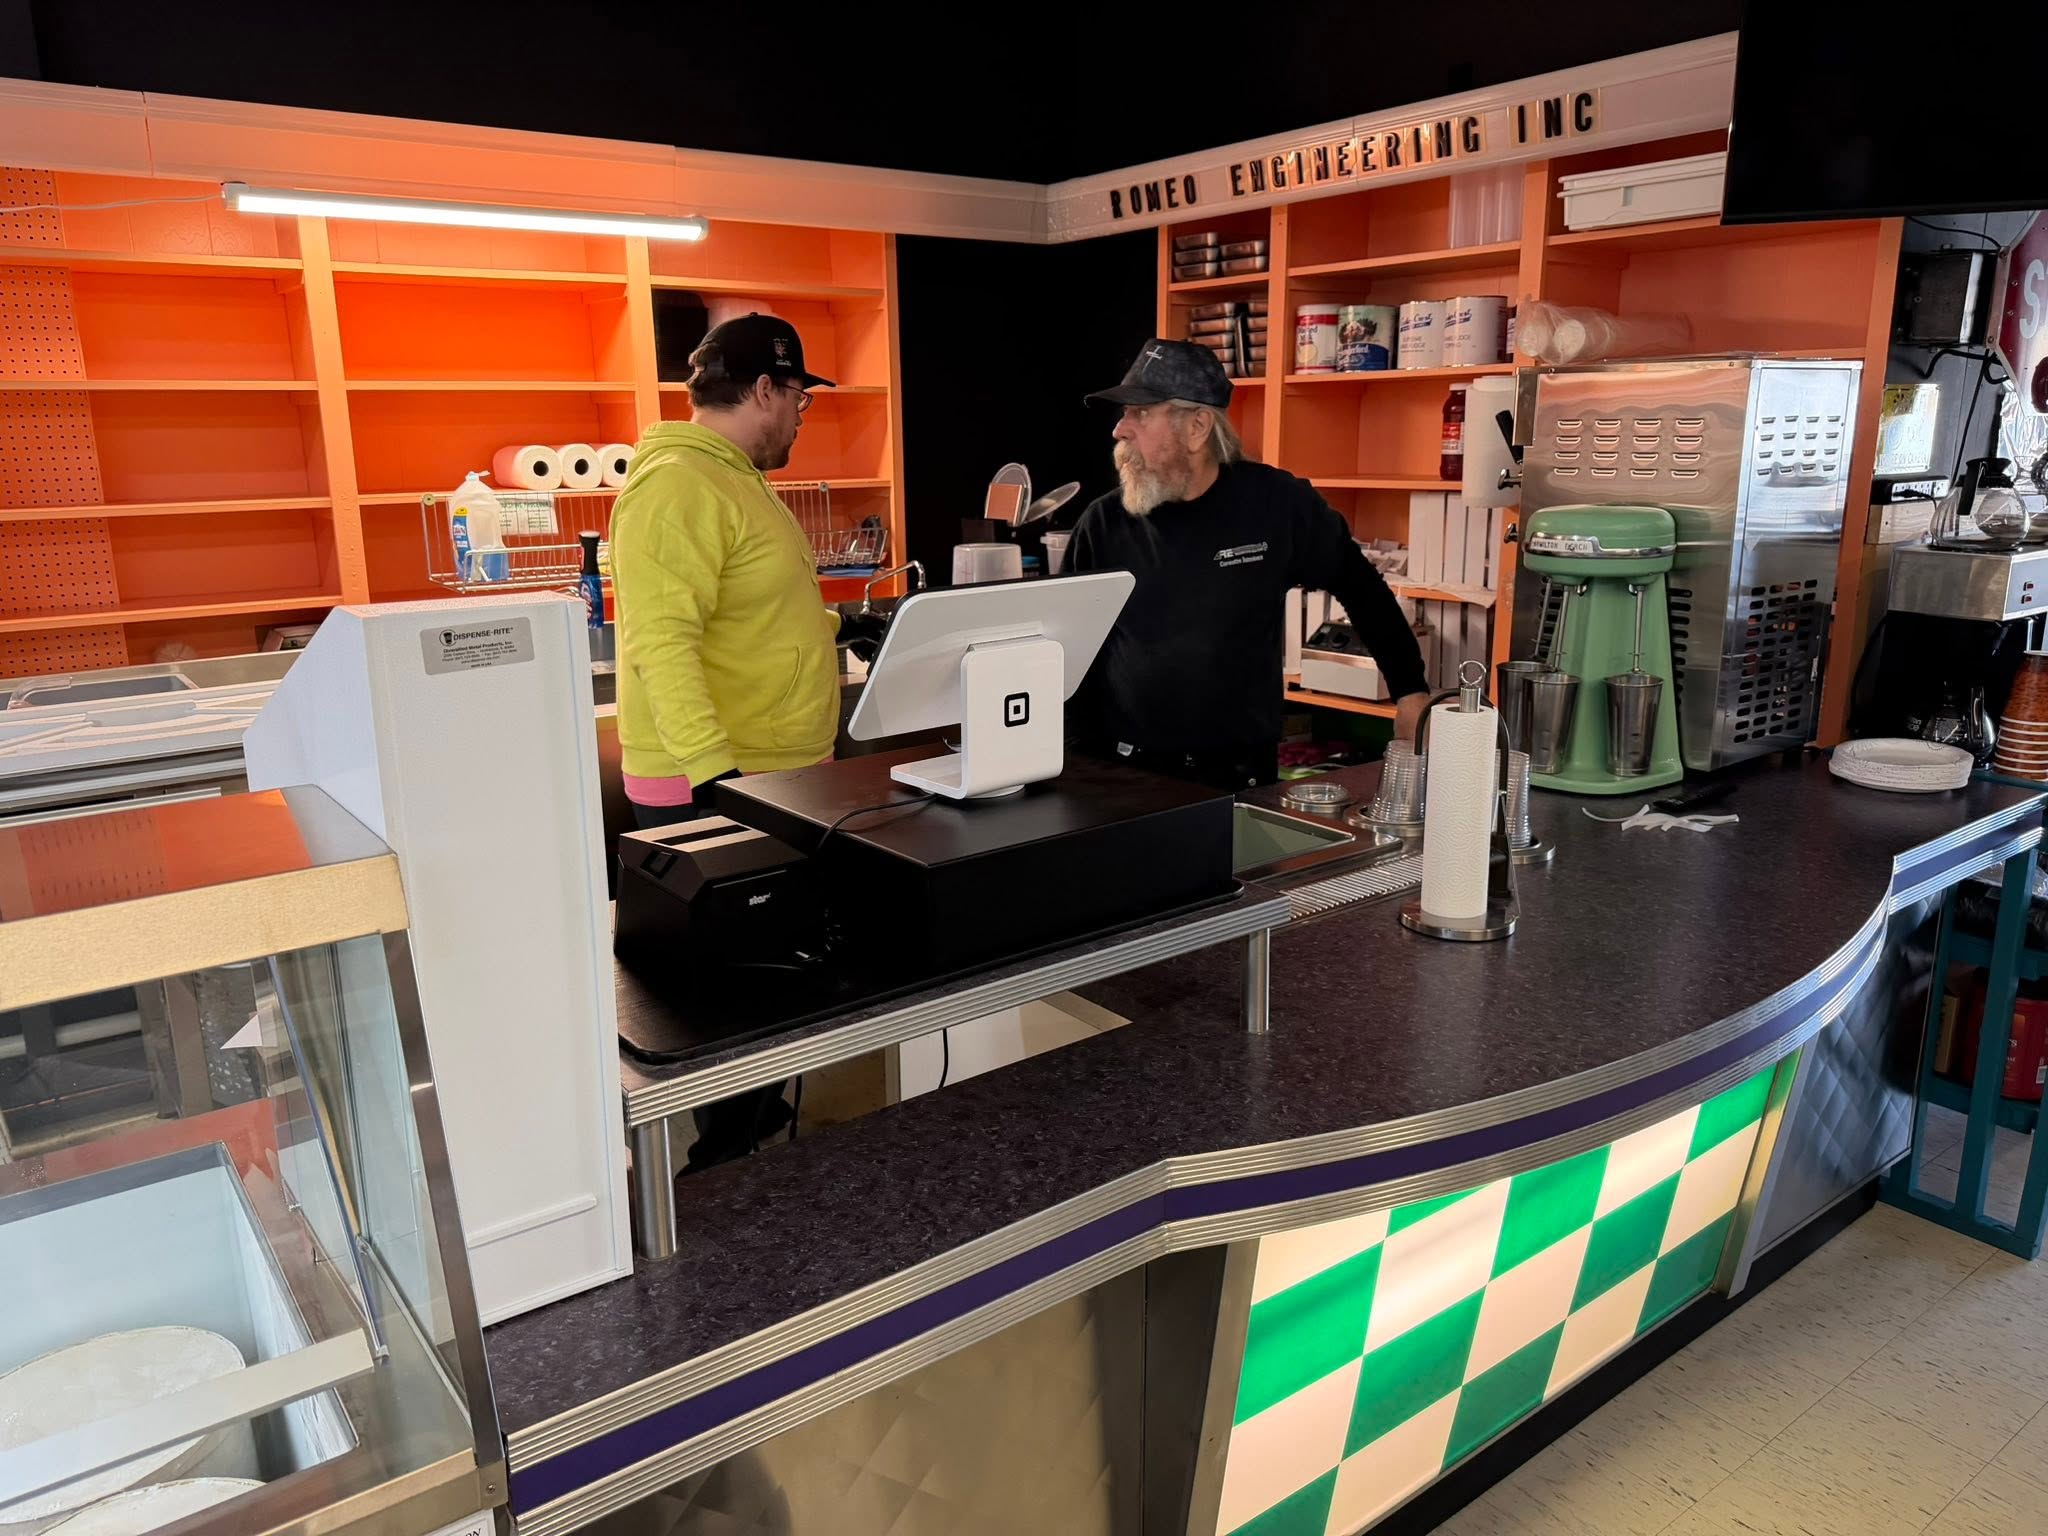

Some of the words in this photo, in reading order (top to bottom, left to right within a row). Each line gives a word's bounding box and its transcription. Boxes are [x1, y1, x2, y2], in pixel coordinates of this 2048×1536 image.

[1110, 174, 1198, 219] ROMEO
[1230, 116, 1481, 197] ENGINEERING
[1517, 91, 1594, 144] INC
